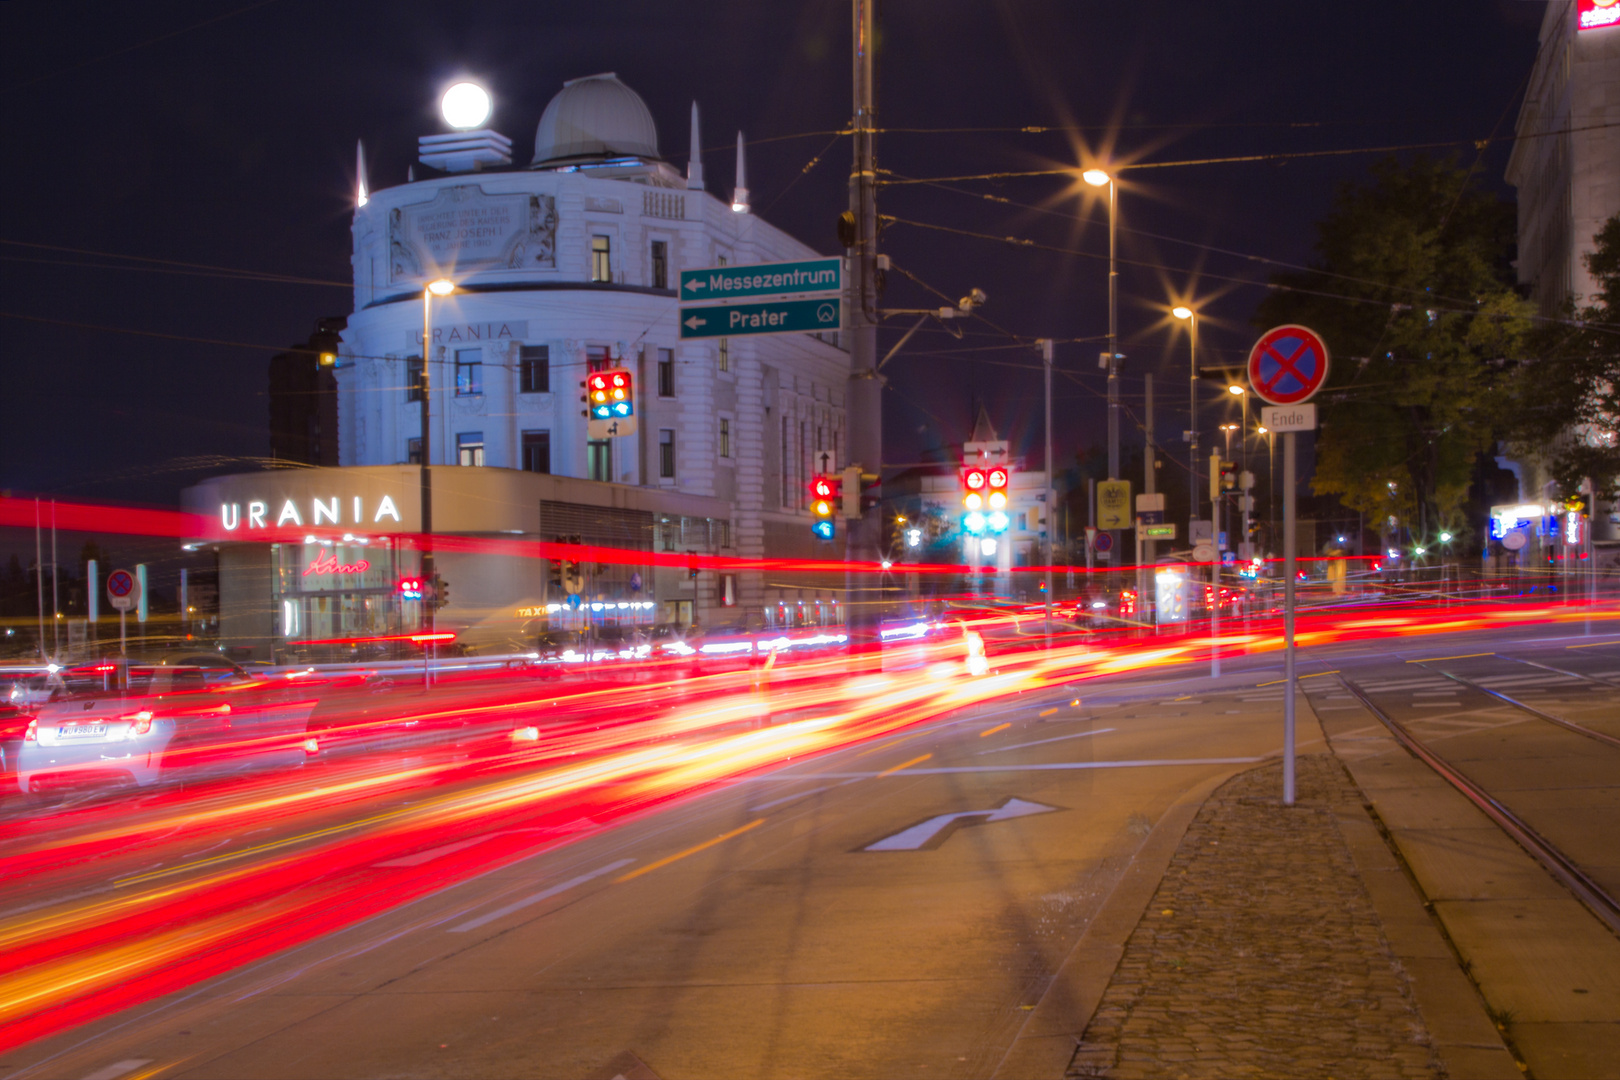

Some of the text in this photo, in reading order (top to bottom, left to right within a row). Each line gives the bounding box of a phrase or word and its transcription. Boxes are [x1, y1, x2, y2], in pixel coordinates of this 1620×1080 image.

[458, 208, 487, 218] UNTER
[490, 207, 508, 216] DER
[417, 215, 511, 232] REGIERUNG DES KAISERS
[423, 230, 451, 243] FRANZ
[454, 226, 496, 238] JOSEPH
[444, 240, 470, 250] JAHRE
[473, 239, 492, 248] 1910
[709, 269, 836, 292] Messezentrum
[729, 309, 788, 328] Prater
[415, 323, 513, 345] URANIA
[1271, 411, 1304, 426] Ende
[221, 494, 401, 531] URANIA
[302, 548, 371, 577] Kino
[518, 606, 545, 617] TAXI
